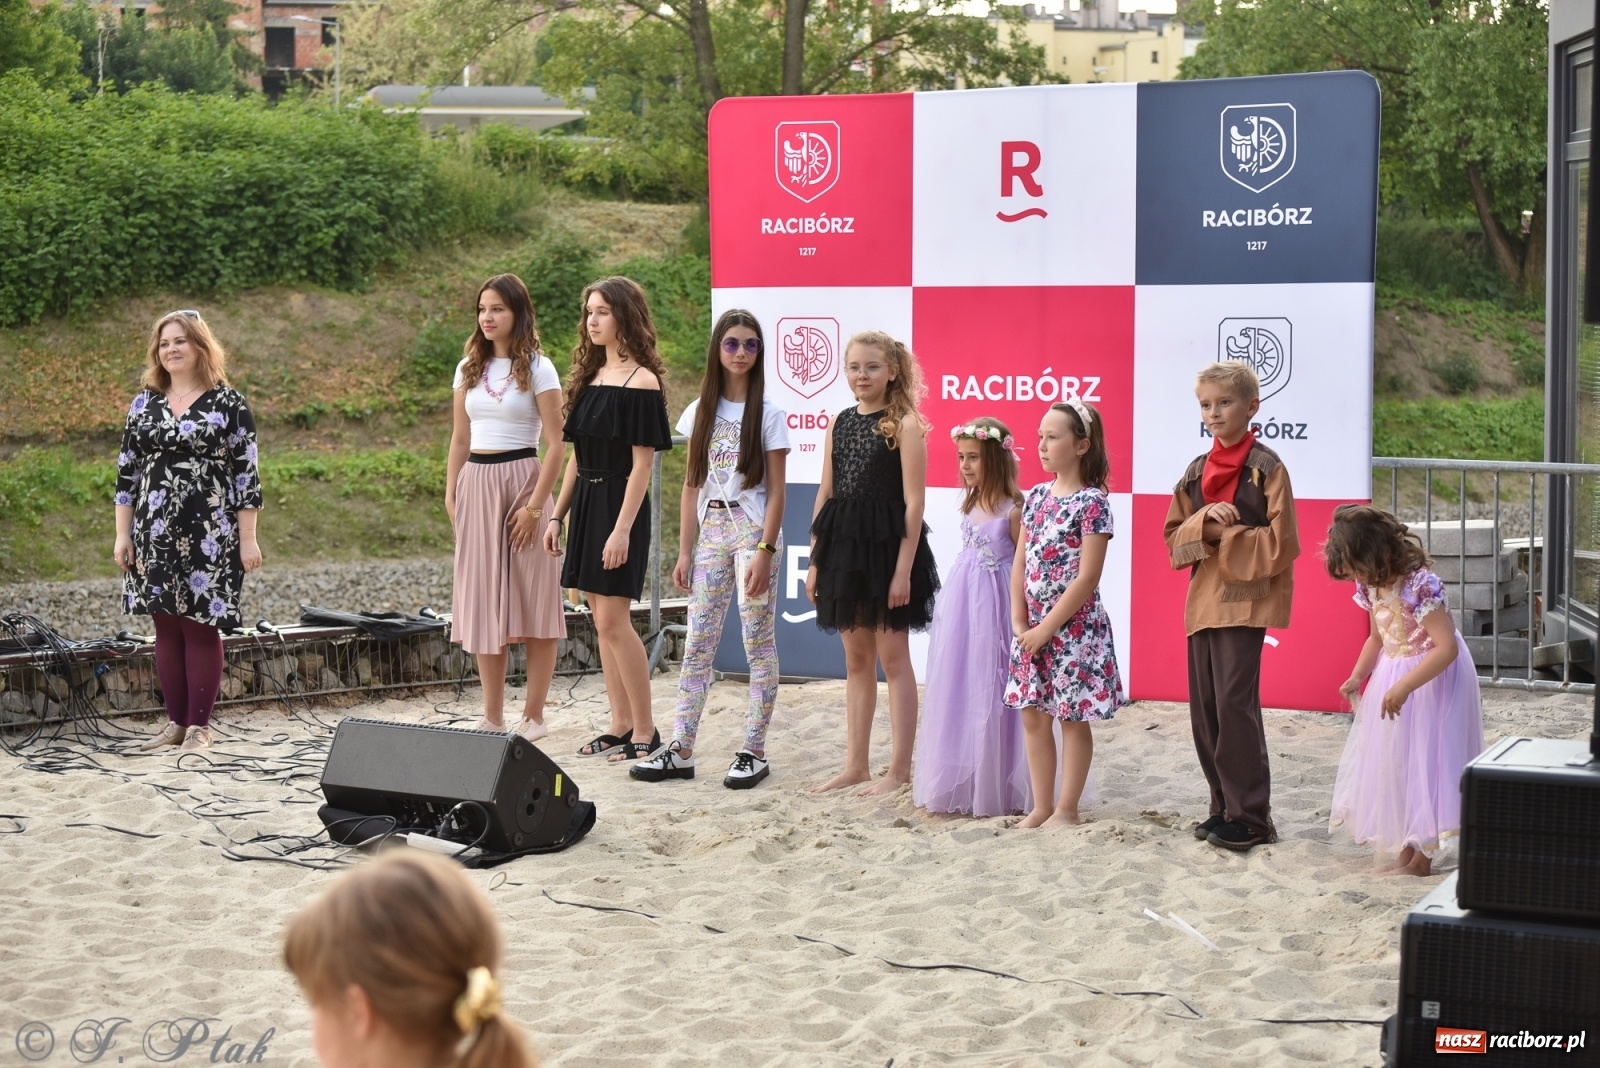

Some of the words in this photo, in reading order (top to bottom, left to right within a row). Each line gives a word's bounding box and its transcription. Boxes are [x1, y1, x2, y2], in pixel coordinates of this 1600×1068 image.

[1001, 141, 1043, 197] R
[761, 211, 855, 235] RACIBÓRZ
[1202, 202, 1313, 228] RACIBÓRZ
[799, 247, 817, 256] 1217
[1247, 241, 1268, 251] 1217
[941, 367, 1101, 402] RACIBÓRZ
[787, 409, 830, 430] CIBÓ
[1200, 417, 1308, 440] RBÓRZ
[799, 444, 816, 452] 1217
